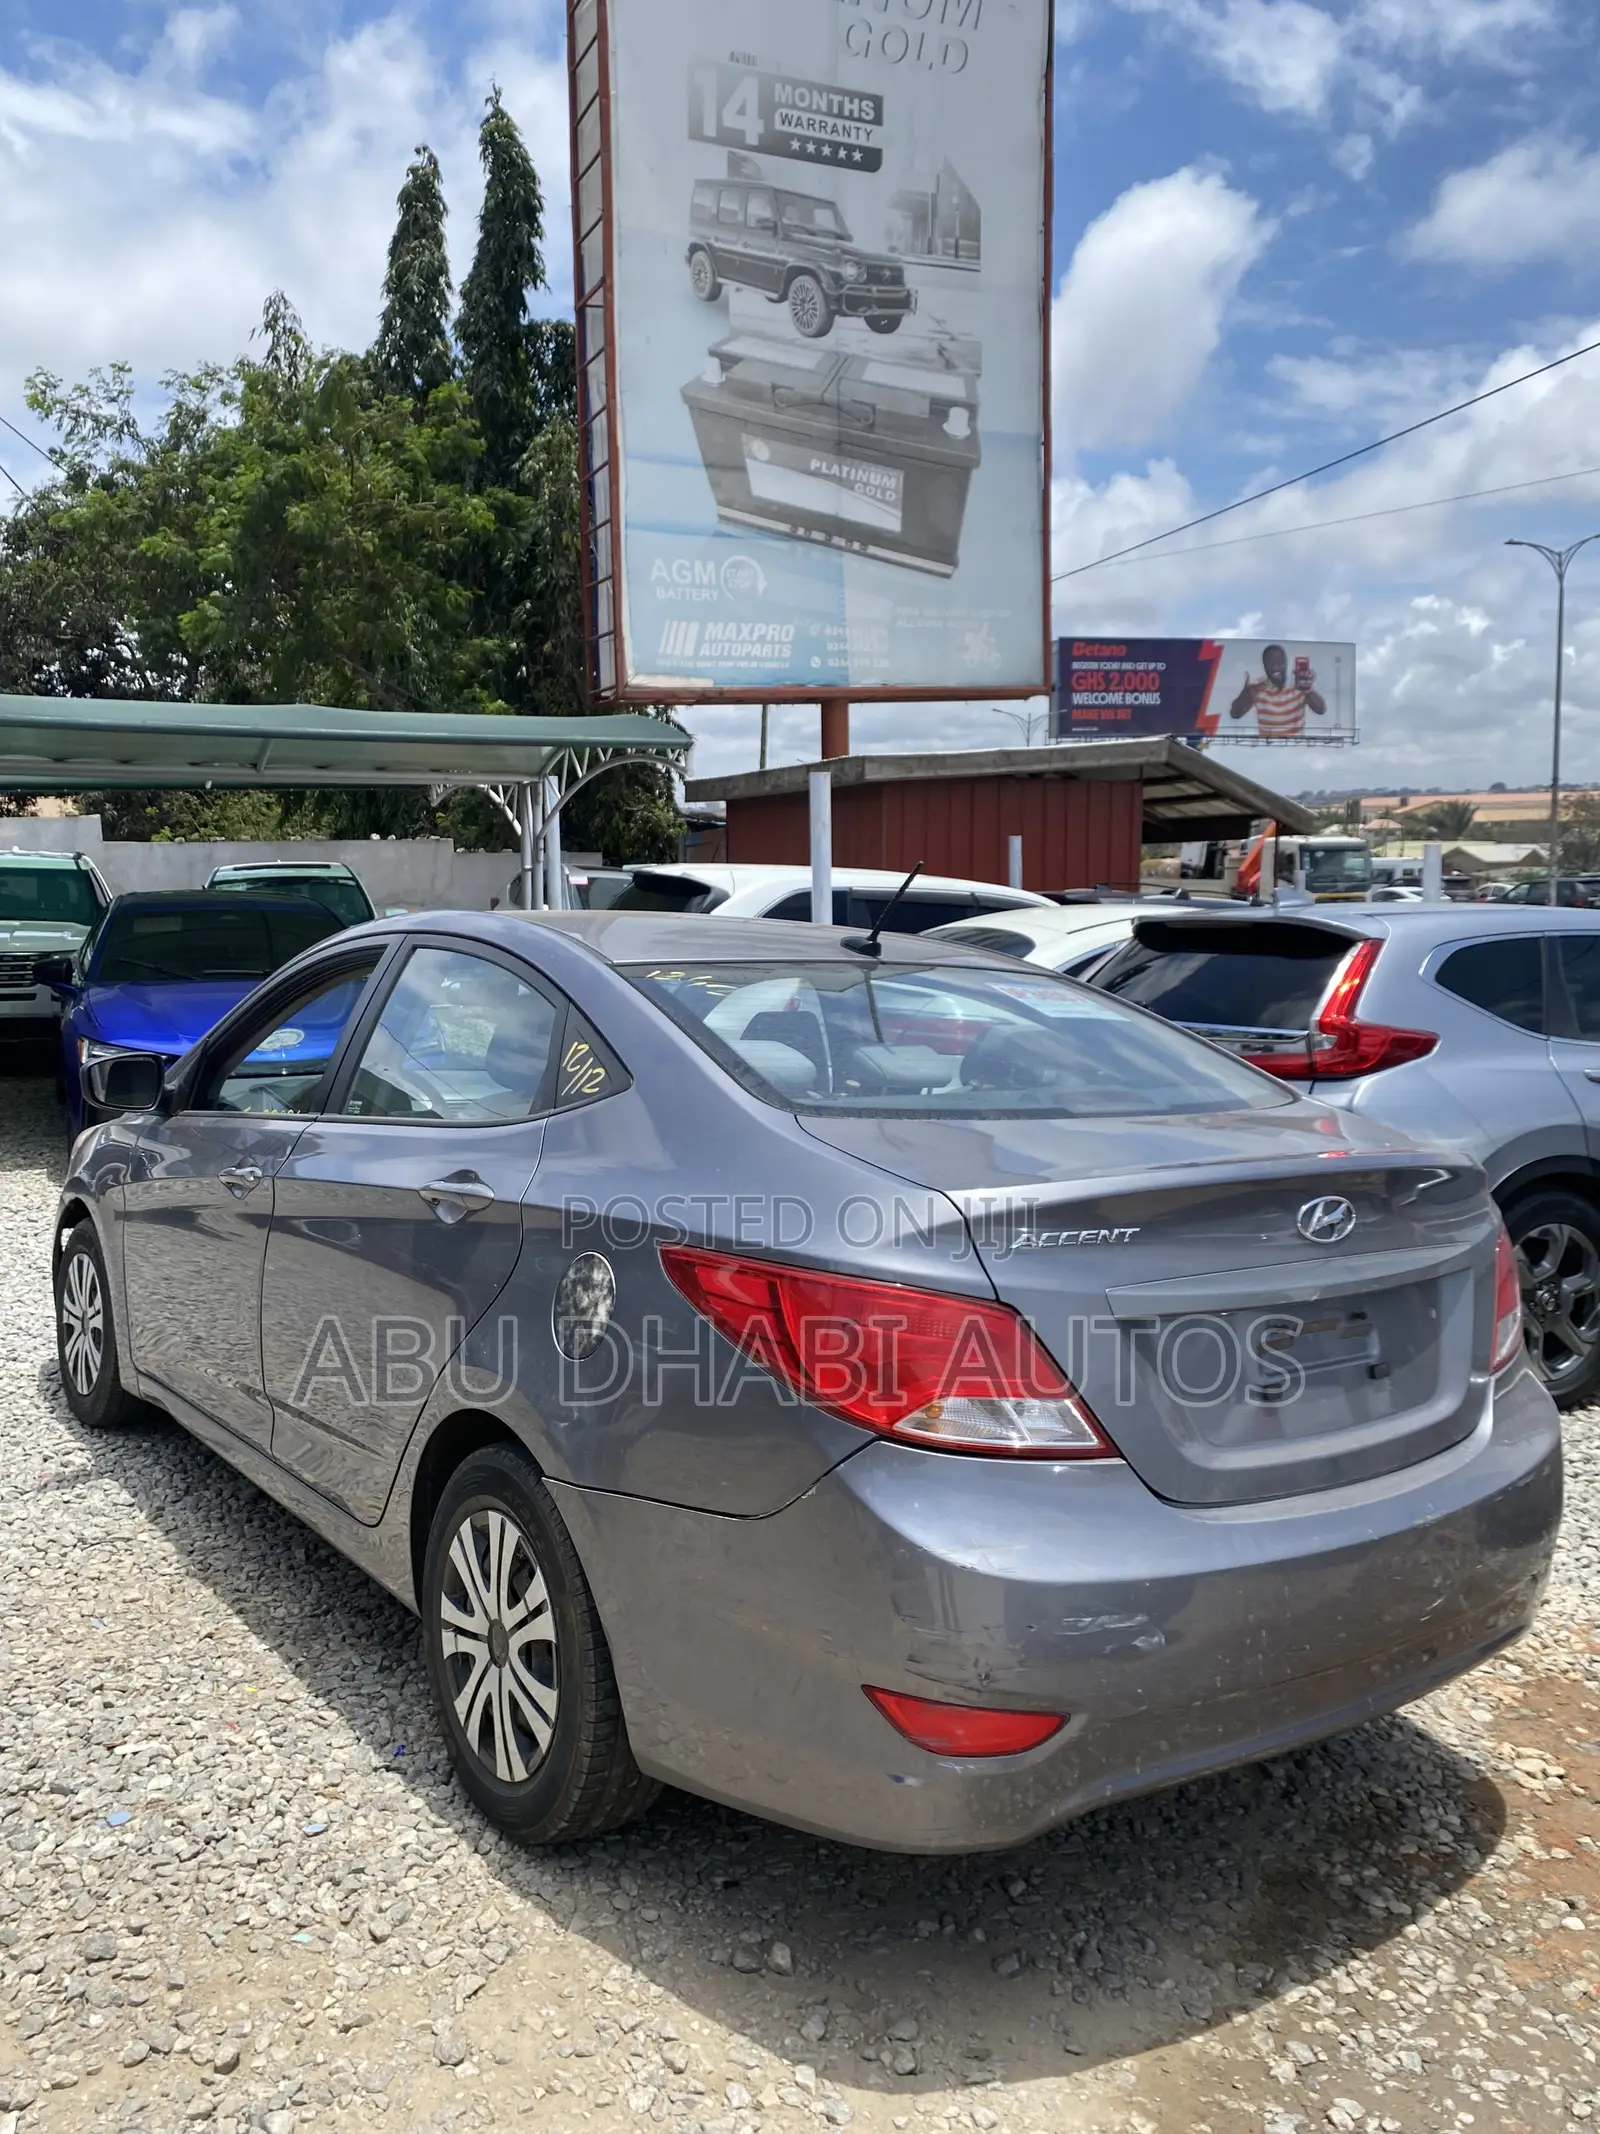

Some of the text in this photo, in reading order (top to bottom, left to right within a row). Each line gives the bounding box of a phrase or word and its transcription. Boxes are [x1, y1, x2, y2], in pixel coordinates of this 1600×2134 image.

[845, 17, 969, 75] GOLD
[692, 67, 765, 147] 14
[774, 82, 876, 121] MONTHS
[780, 111, 874, 142] WARRANTY
[809, 458, 897, 490] PLATINUM
[854, 482, 896, 501] GOLD
[650, 557, 717, 586] AGM
[656, 587, 721, 601] BATTERY
[704, 621, 795, 642] MAXPRO
[699, 642, 793, 658] AUTOPARTS
[1072, 671, 1160, 692] GHS 2,000
[1072, 692, 1161, 705] WELCOME BONUS
[1009, 1227, 1141, 1249] ACCENT
